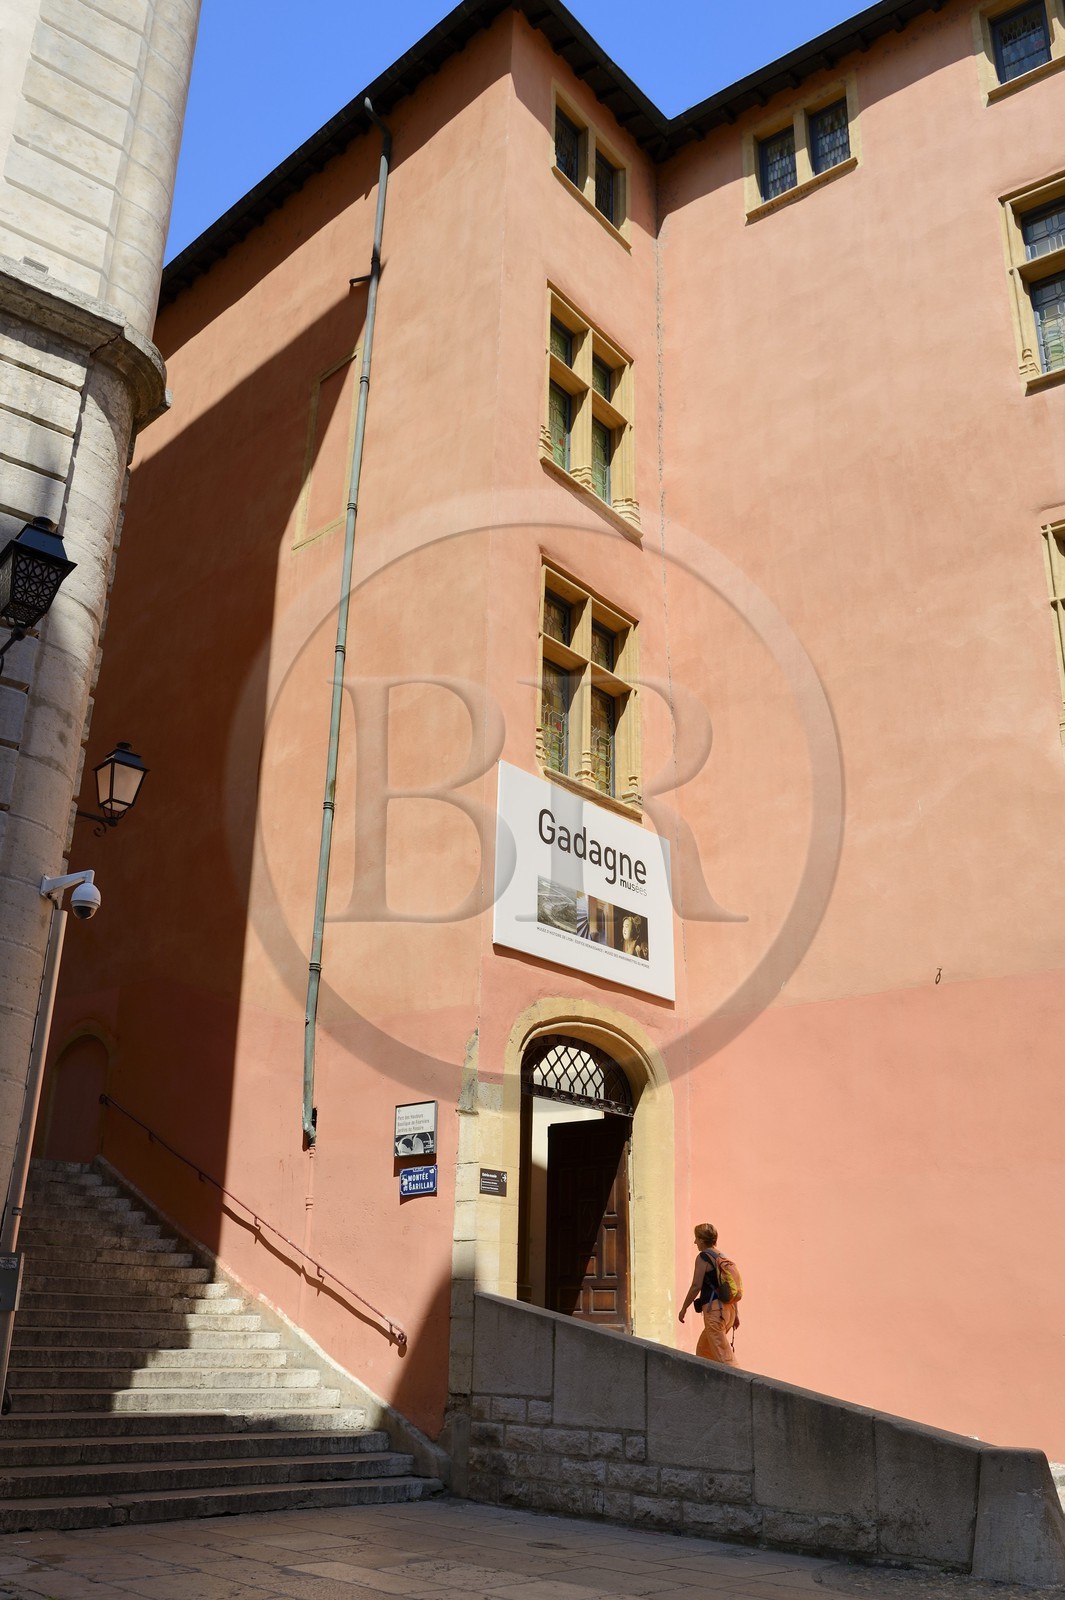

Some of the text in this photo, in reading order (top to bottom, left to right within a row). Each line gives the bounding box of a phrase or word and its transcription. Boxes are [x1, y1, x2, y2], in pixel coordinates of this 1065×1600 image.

[538, 808, 647, 885] Gadagne
[619, 878, 648, 897] musées
[407, 1172, 428, 1181] MONTÉE
[408, 1181, 434, 1191] GARILLAN
